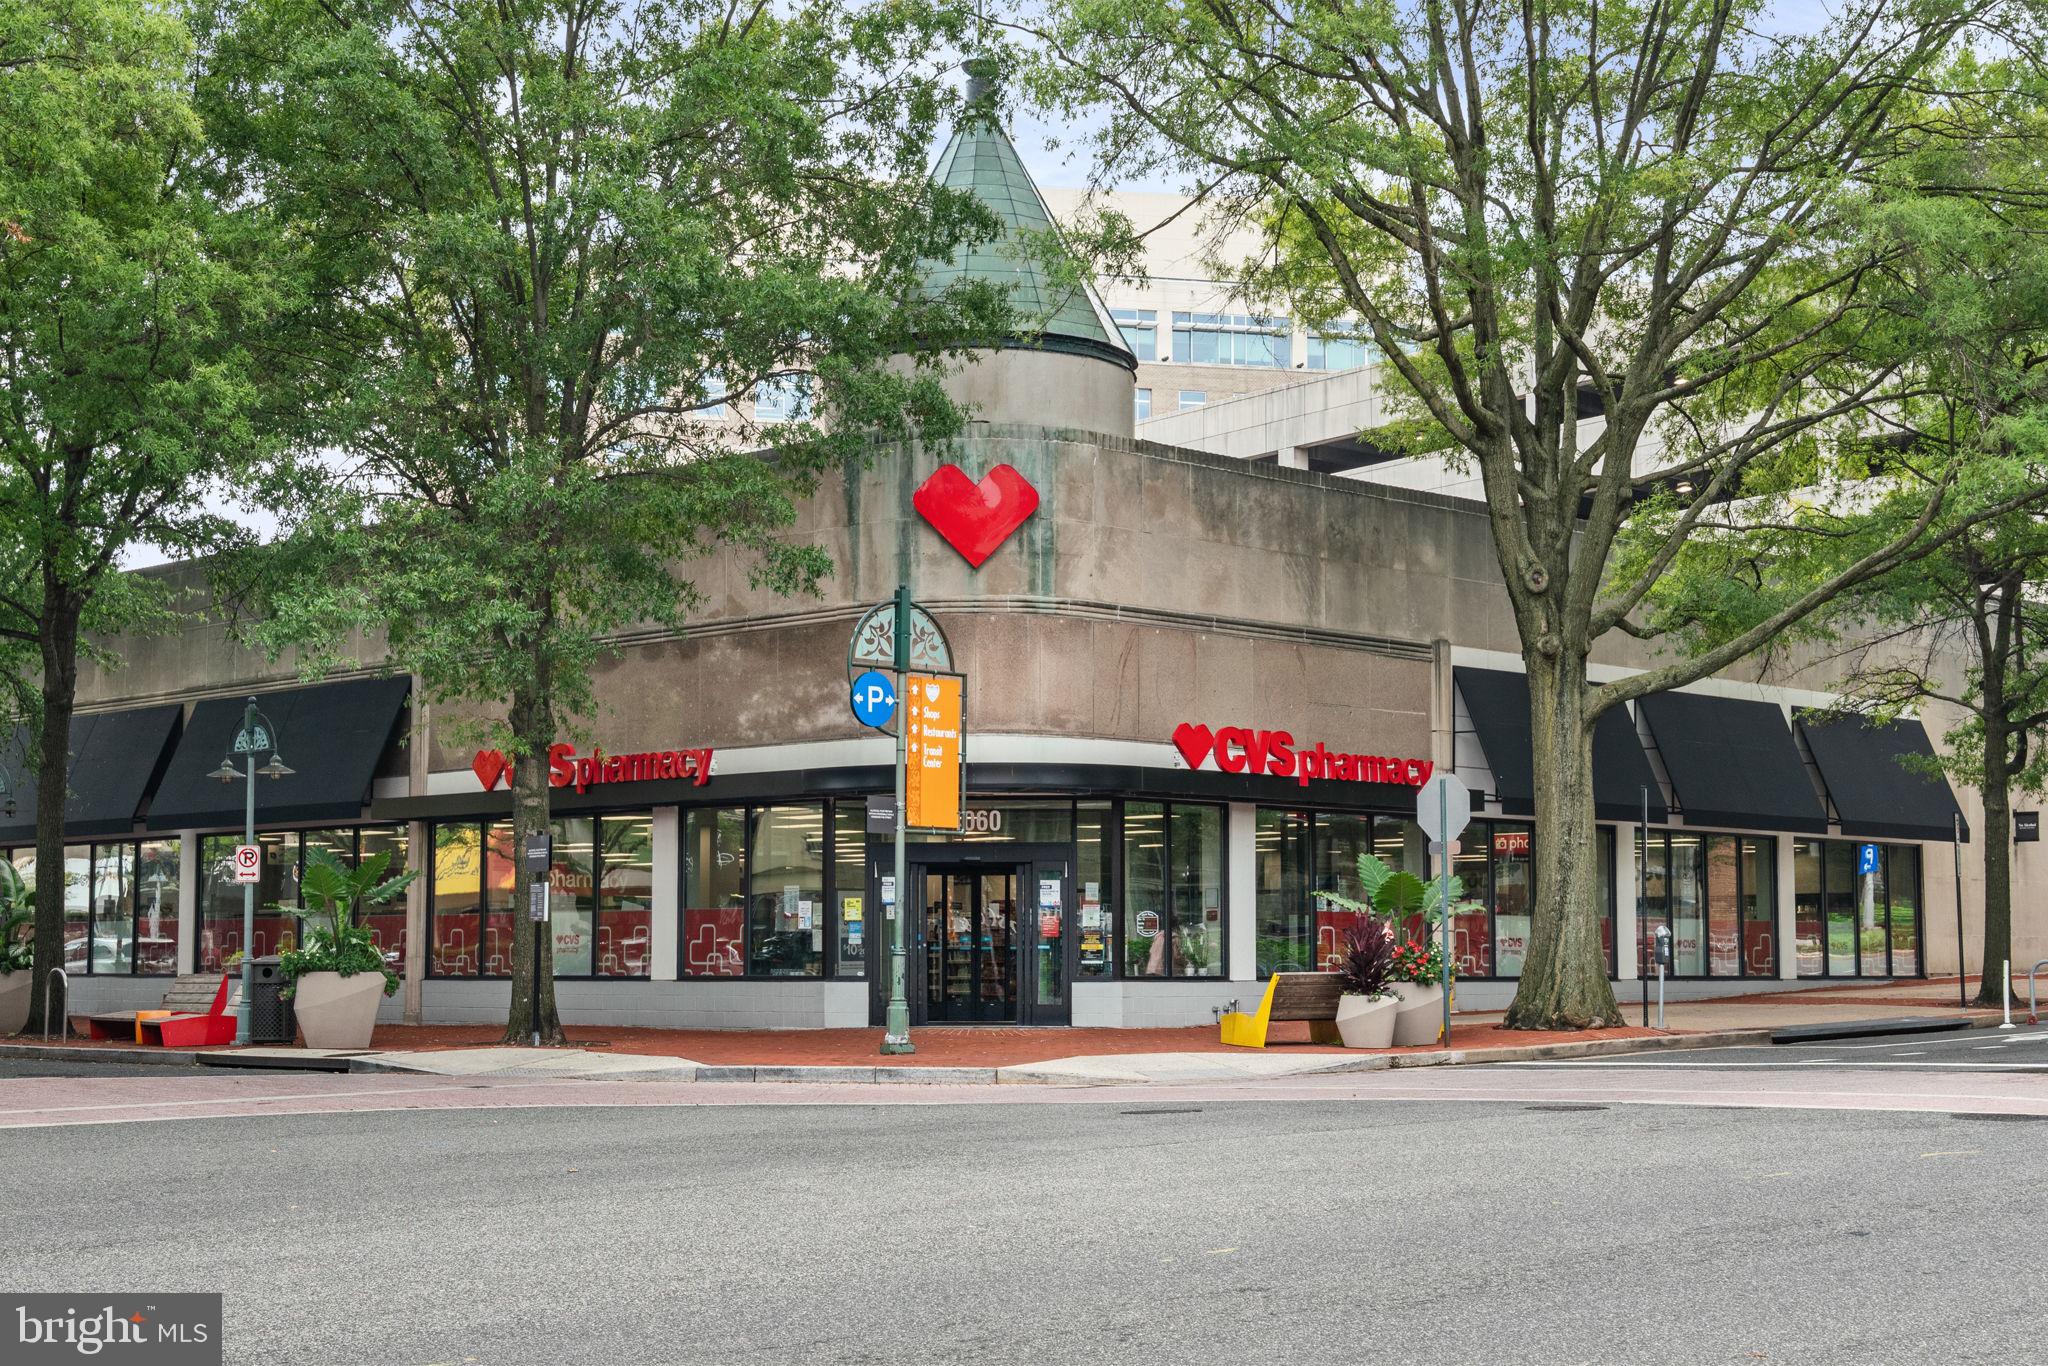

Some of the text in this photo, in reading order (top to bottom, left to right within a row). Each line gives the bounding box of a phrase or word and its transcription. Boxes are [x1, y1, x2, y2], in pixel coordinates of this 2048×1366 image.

[867, 685, 884, 713] P
[923, 706, 940, 721] Shops
[923, 724, 957, 739] Restaurants
[923, 742, 943, 756] Transit
[923, 755, 943, 768] Center
[1213, 726, 1434, 795] CVS pharmacy
[576, 747, 714, 795] pharmacy
[959, 810, 1001, 831] 060
[564, 935, 580, 945] CVS
[1683, 939, 1697, 949] CVS
